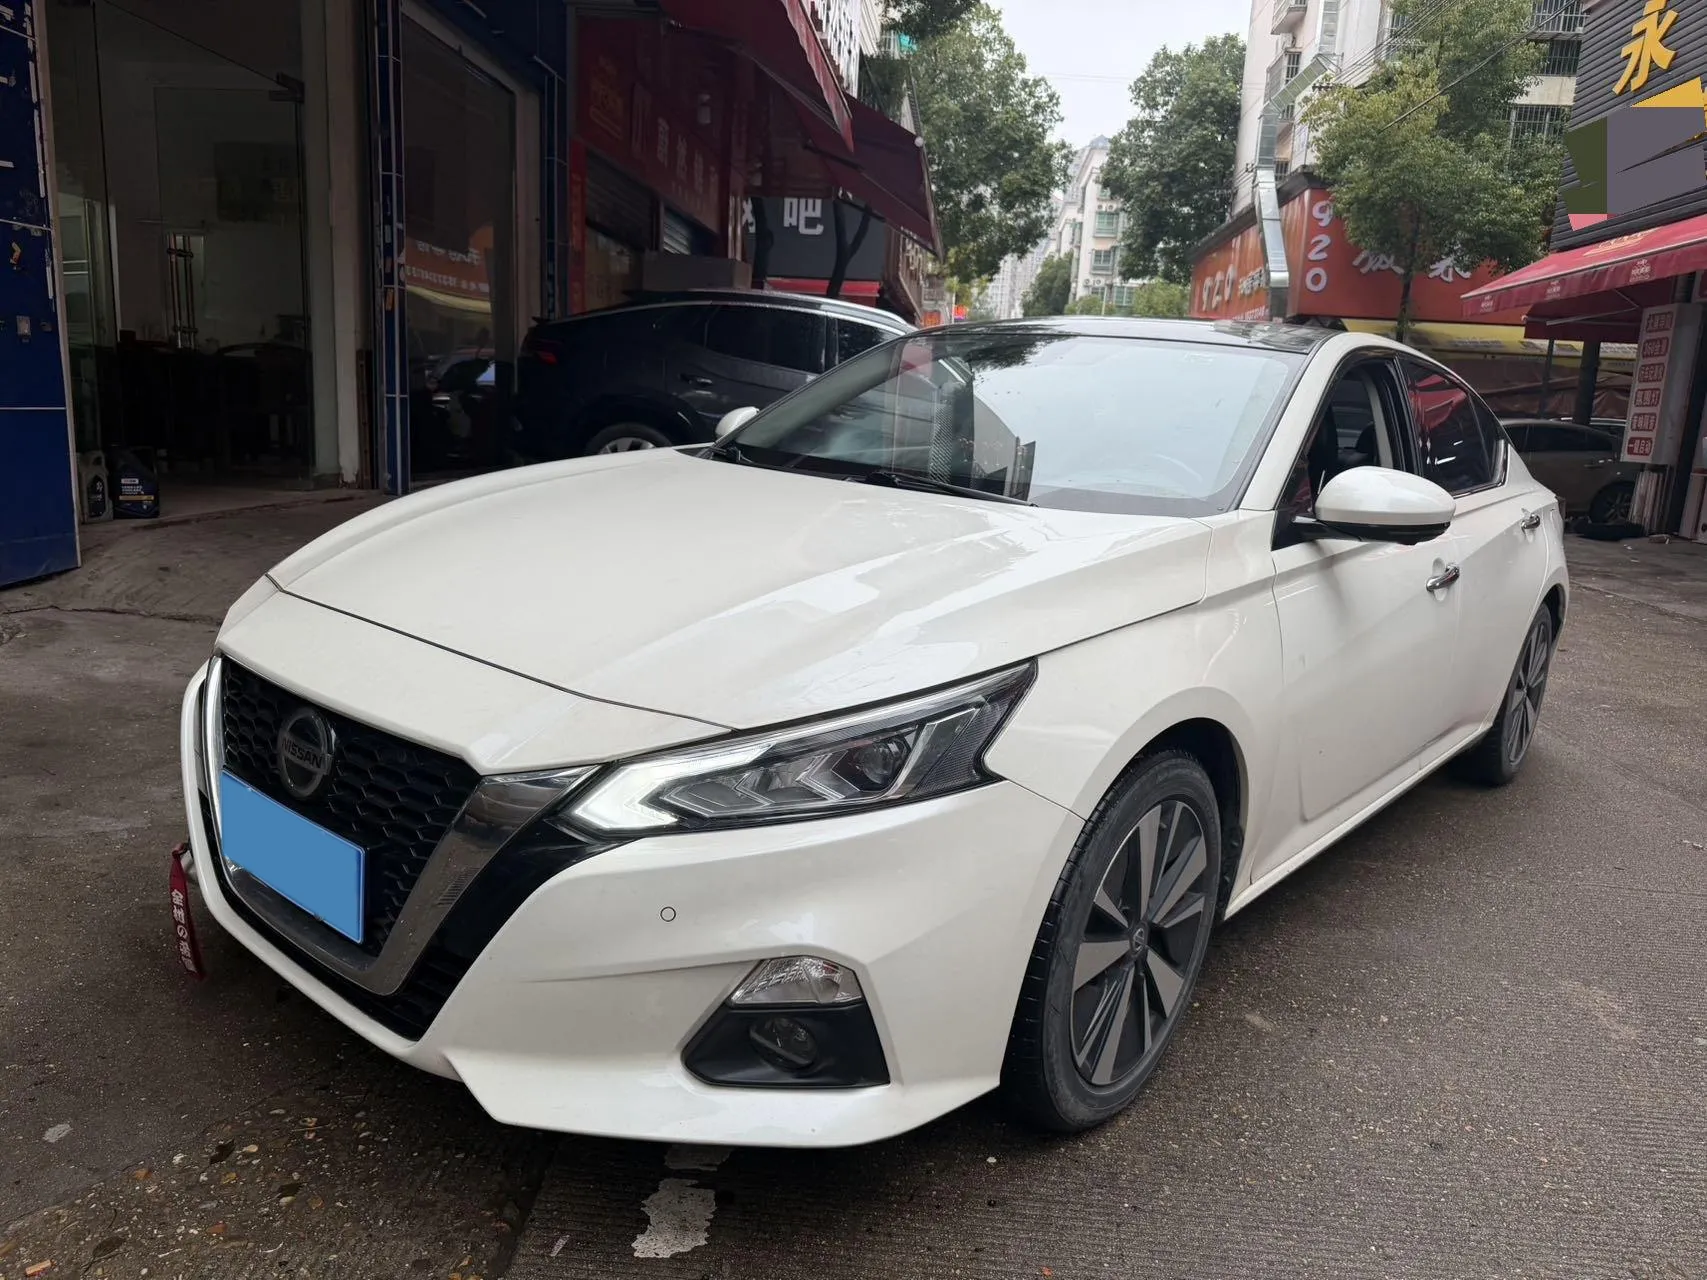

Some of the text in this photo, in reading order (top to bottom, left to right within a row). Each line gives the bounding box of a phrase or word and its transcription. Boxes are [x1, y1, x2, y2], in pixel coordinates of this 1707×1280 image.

[1612, 0, 1679, 95] 永
[1305, 200, 1333, 292] 920
[1628, 439, 1652, 454] 一键启动
[281, 737, 323, 769] NISSAN
